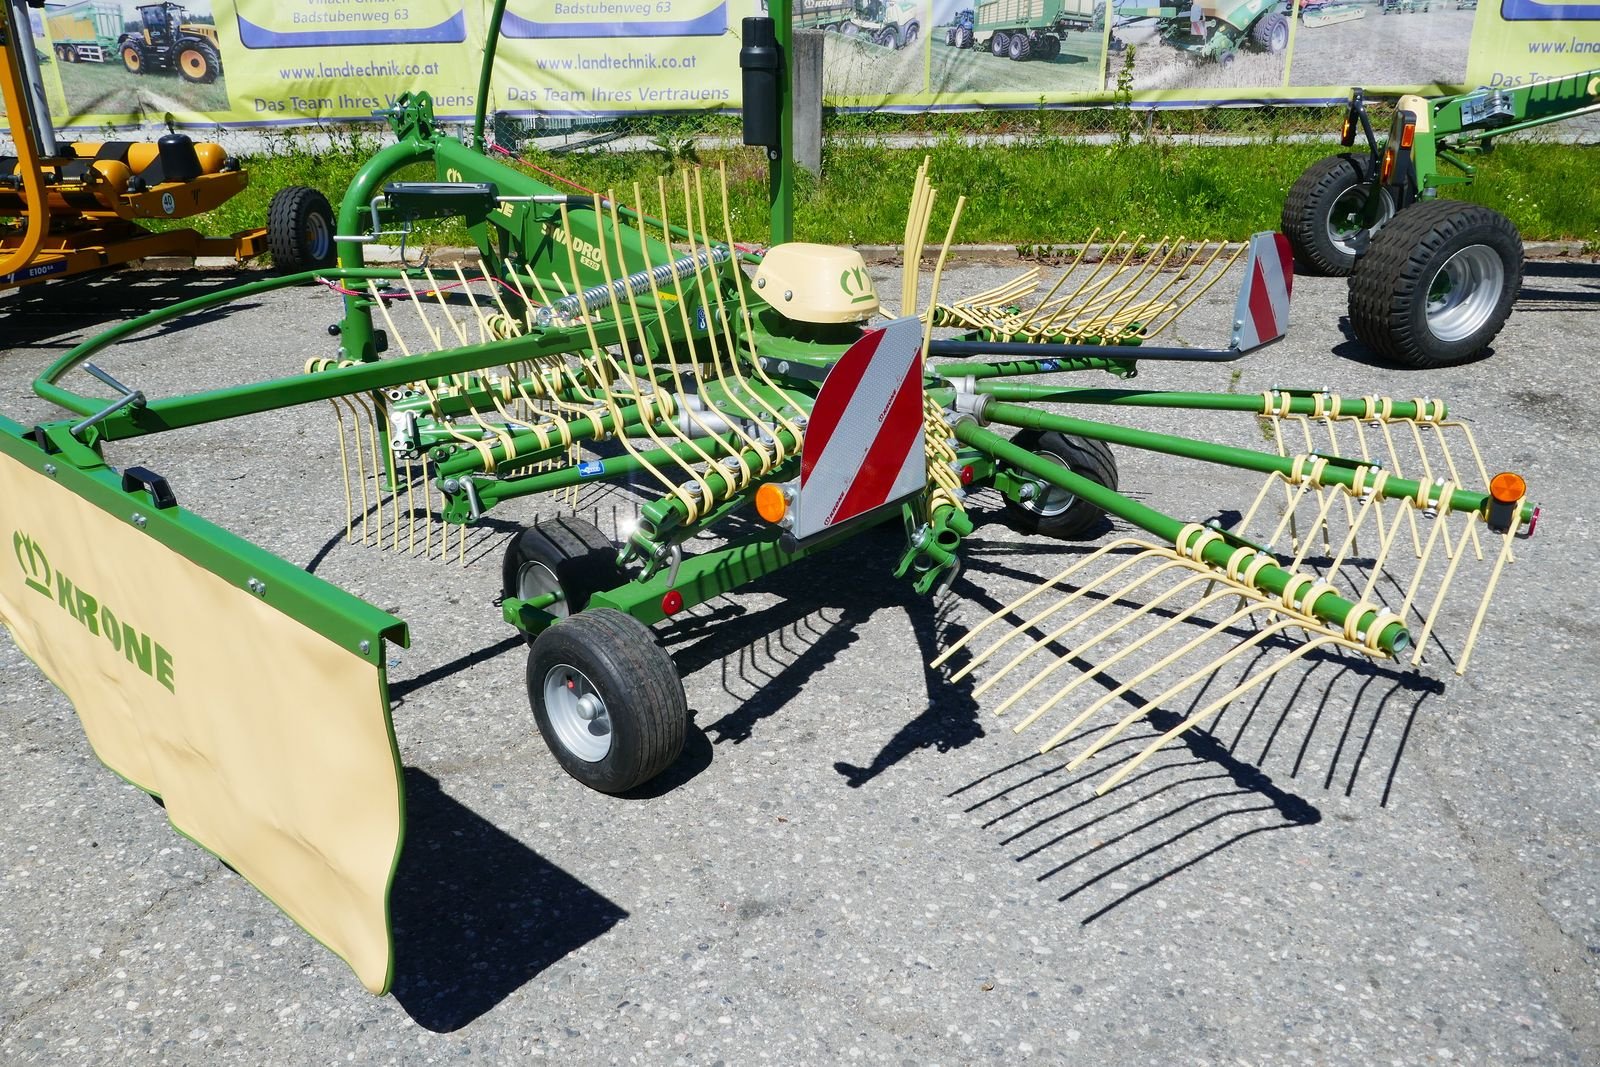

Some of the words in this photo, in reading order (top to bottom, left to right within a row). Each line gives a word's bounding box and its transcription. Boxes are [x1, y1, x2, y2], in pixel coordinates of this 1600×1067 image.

[293, 10, 389, 23] Badstubenweg
[394, 9, 409, 20] 63
[554, 2, 651, 15] Badstubenweg
[655, 2, 672, 13] 63
[280, 61, 439, 79] www.landtechnik.co.at
[536, 54, 697, 70] www.landtechnik.co.at
[1490, 72, 1522, 87] Das
[507, 87, 537, 102] Das
[543, 87, 585, 102] Team
[592, 87, 632, 102] Ihres
[638, 86, 730, 101] Vertrauens
[254, 98, 285, 112] Das
[289, 96, 333, 110] Team
[338, 94, 380, 108] Ihres
[384, 93, 474, 107] Vuens
[56, 569, 175, 695] KRONE
